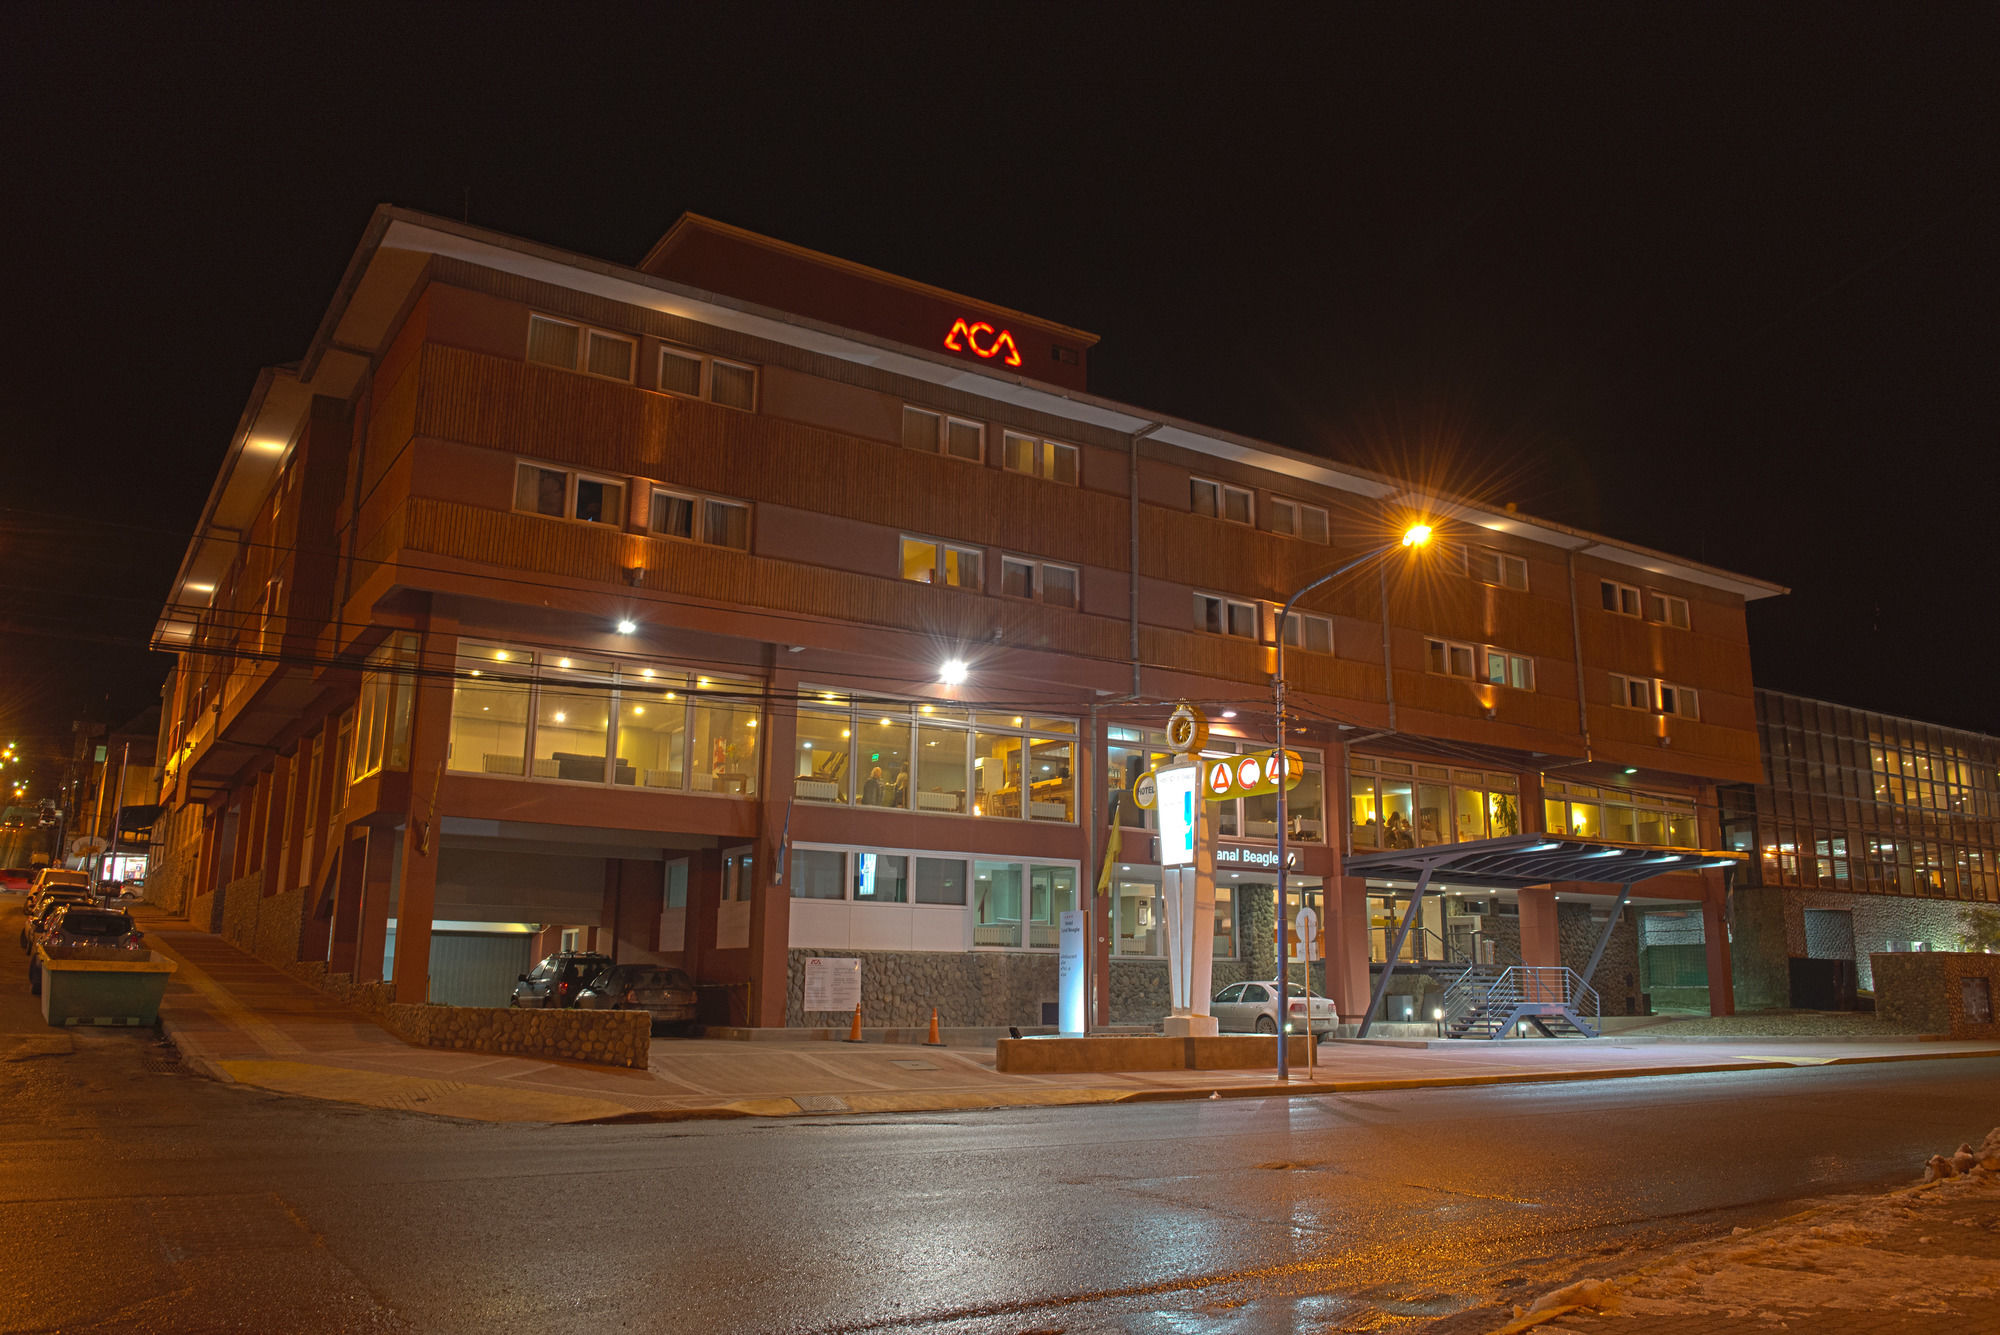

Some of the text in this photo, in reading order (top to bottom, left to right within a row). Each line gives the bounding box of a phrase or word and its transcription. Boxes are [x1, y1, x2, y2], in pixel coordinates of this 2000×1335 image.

[944, 317, 1022, 367] ACA
[1216, 848, 1279, 867] anal Beagle
